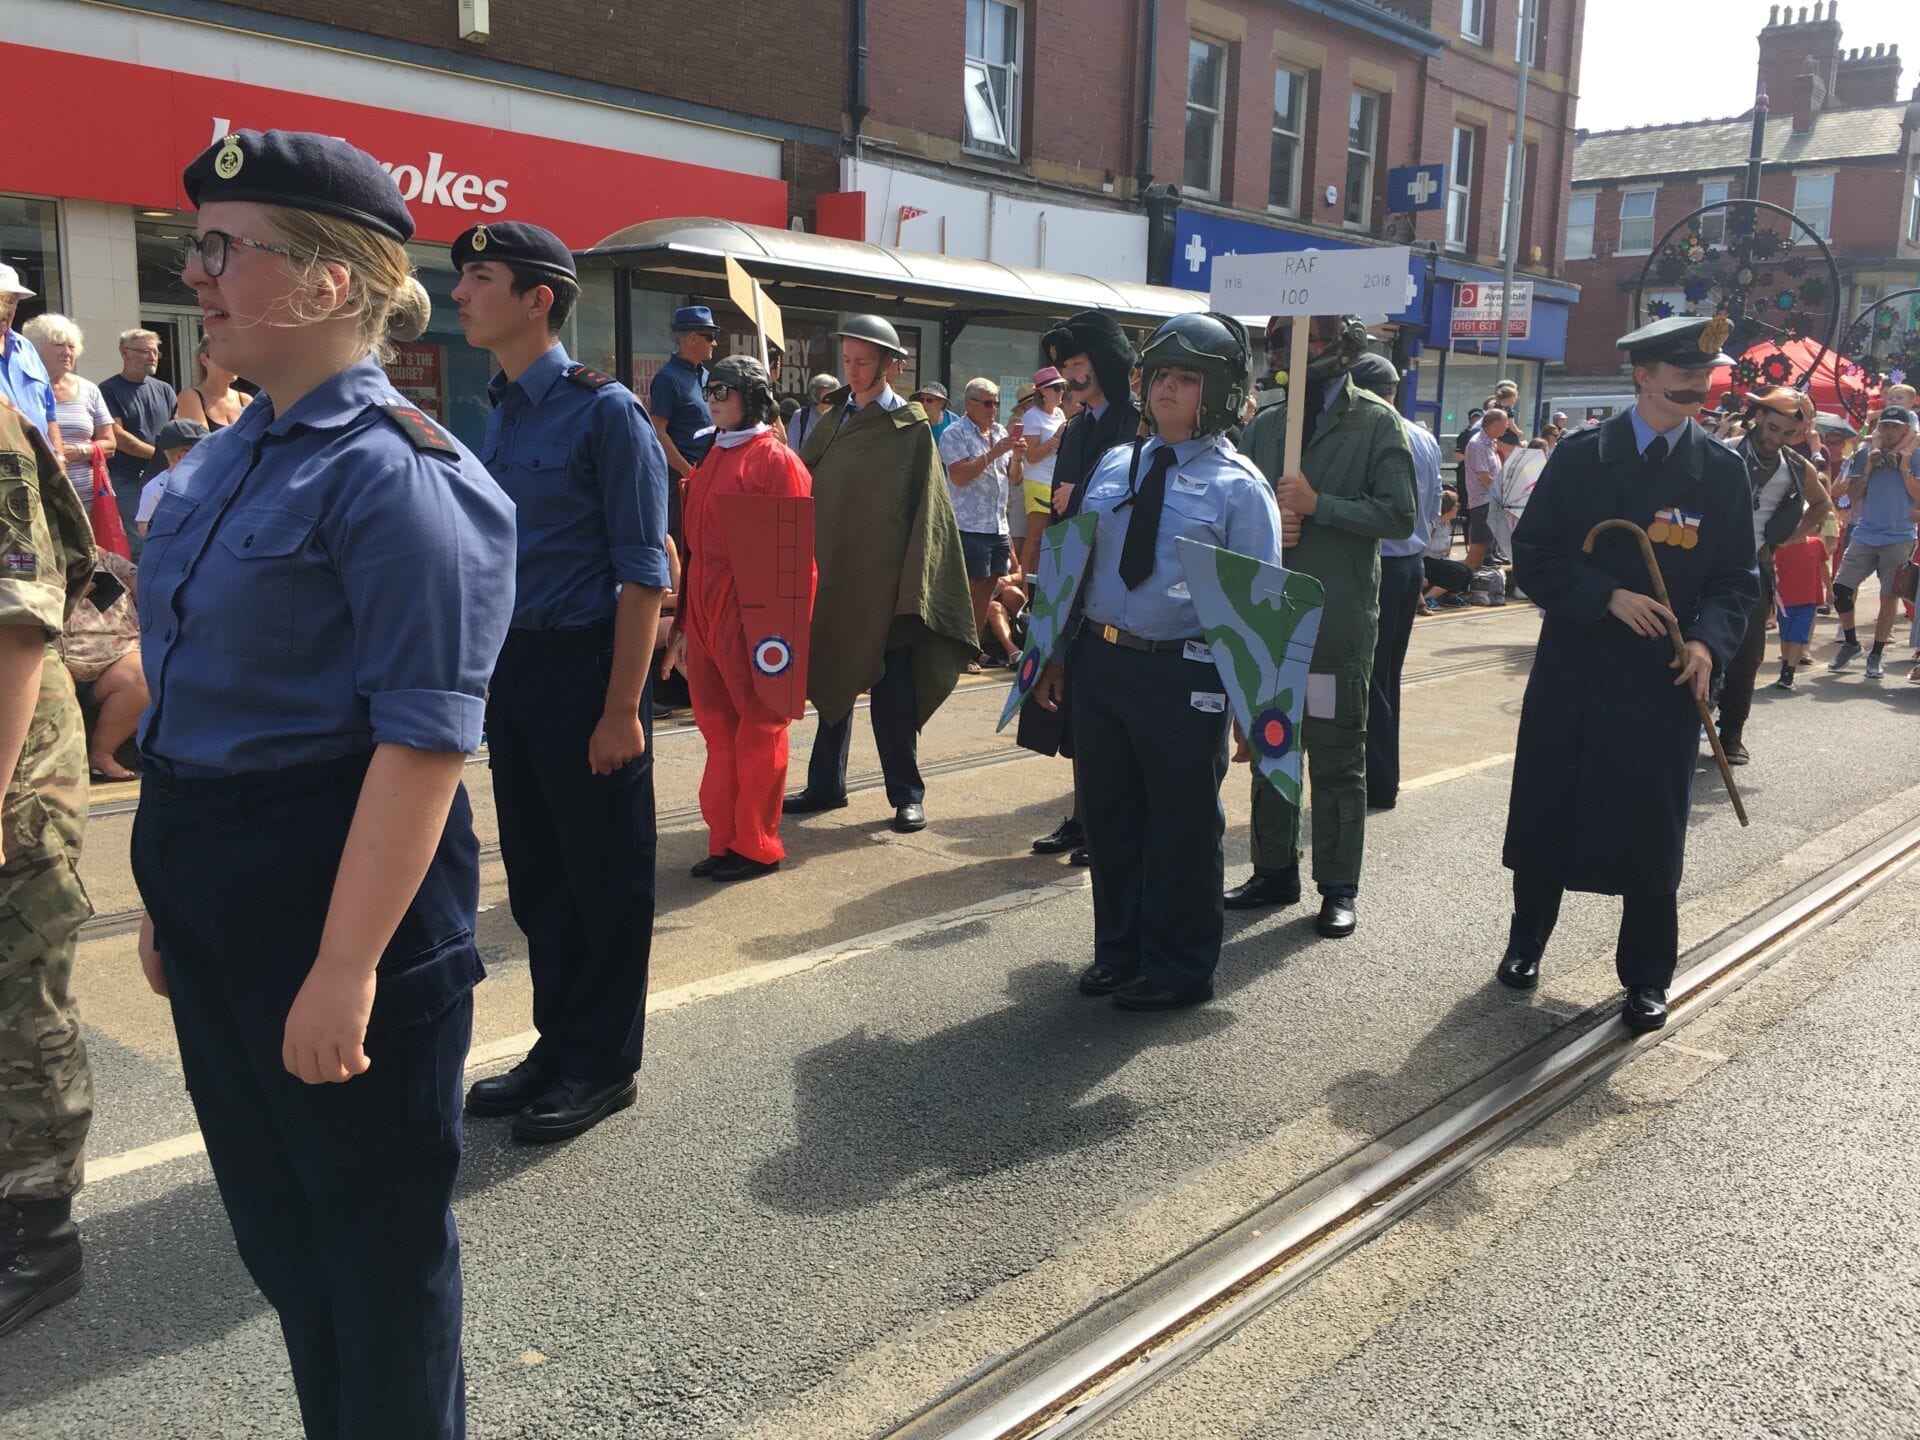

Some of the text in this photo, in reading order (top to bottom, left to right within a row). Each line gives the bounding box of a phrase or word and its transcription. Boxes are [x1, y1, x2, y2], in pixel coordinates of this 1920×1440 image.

[1285, 256, 1318, 275] RAF
[1363, 274, 1392, 289] 2018
[1281, 289, 1310, 305] 100
[1484, 292, 1527, 301] Avable
[1453, 321, 1476, 331] 0161
[1479, 321, 1497, 331] 631
[415, 352, 434, 366] THE
[391, 366, 424, 380] CORE?
